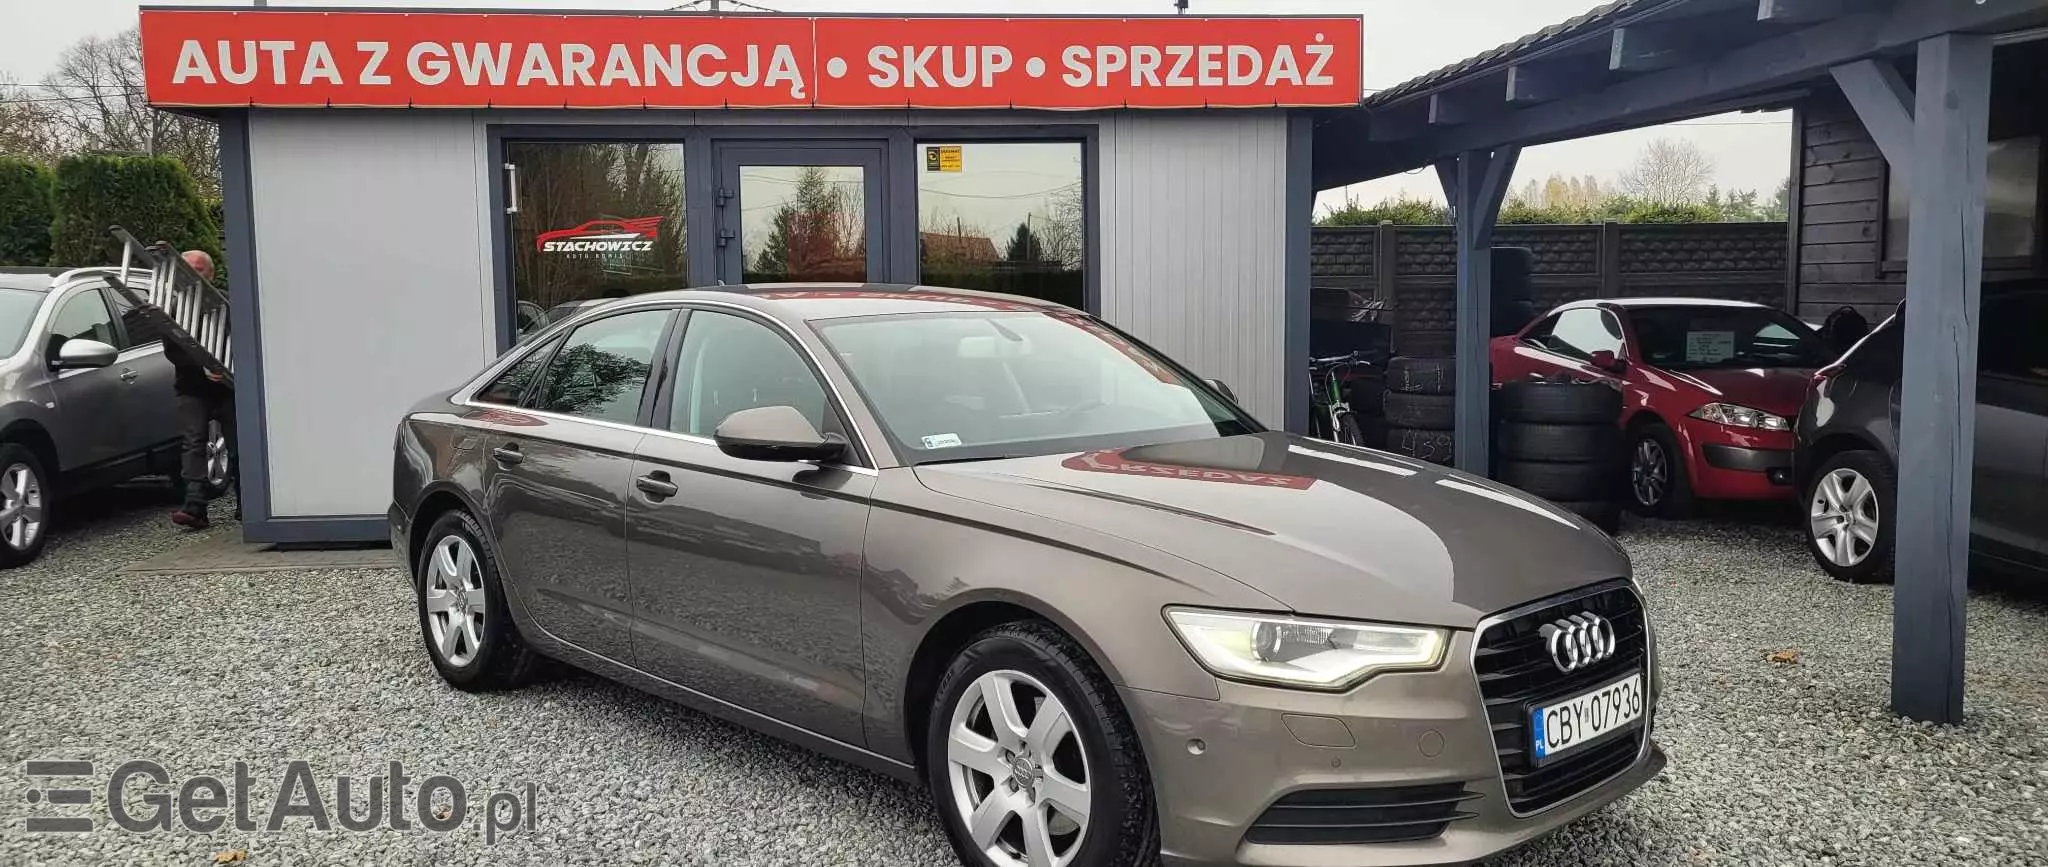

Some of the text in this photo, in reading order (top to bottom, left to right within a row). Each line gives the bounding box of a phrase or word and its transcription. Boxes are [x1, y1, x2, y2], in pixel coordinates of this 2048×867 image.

[172, 32, 1334, 100] AUTA Z GWARANCJĄ SKUP SPRZEDAŻ
[543, 240, 653, 252] STACHOWICZ
[1546, 678, 1640, 749] CBY 07936
[1535, 739, 1545, 752] PL
